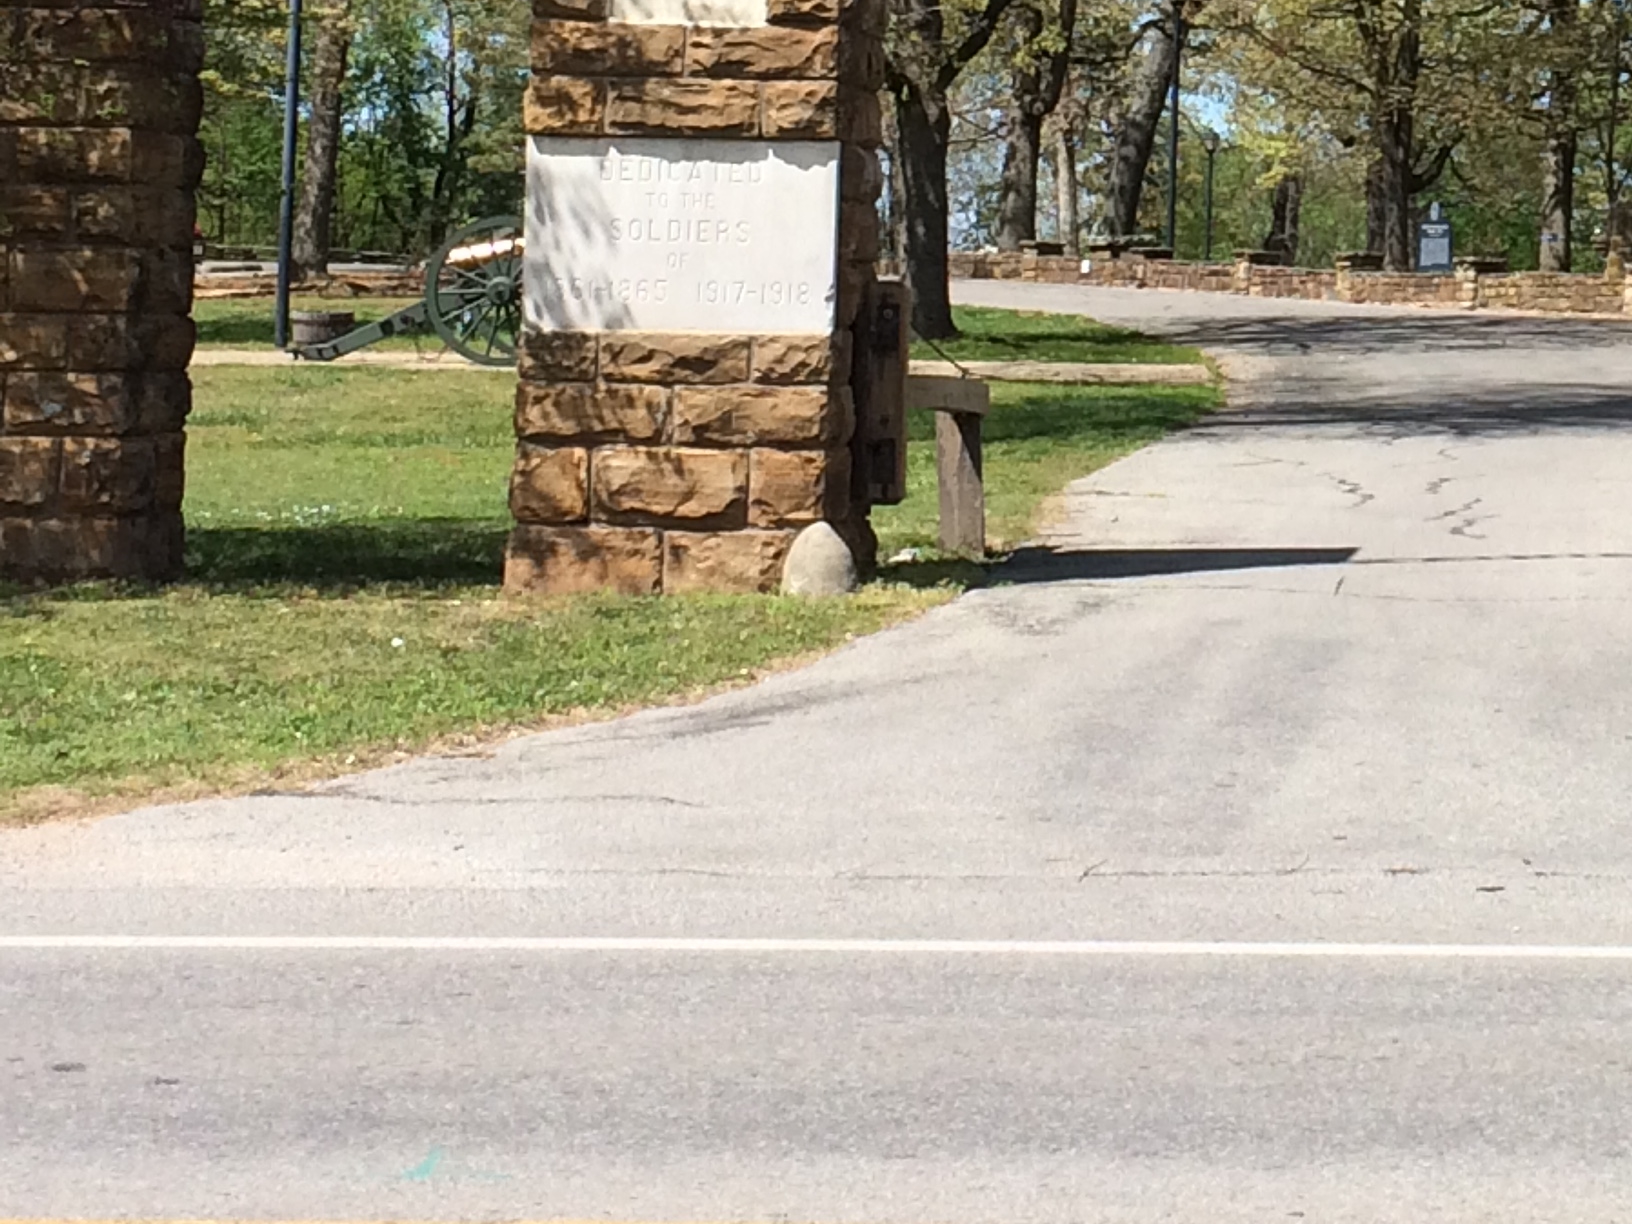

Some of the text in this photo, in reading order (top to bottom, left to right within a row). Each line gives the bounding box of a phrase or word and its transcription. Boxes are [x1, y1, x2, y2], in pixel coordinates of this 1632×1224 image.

[600, 158, 764, 184] DEDICATED
[680, 191, 716, 210] THE
[609, 217, 751, 245] SOLDIERS
[666, 251, 689, 271] OF
[697, 279, 812, 306] 1917-1918
